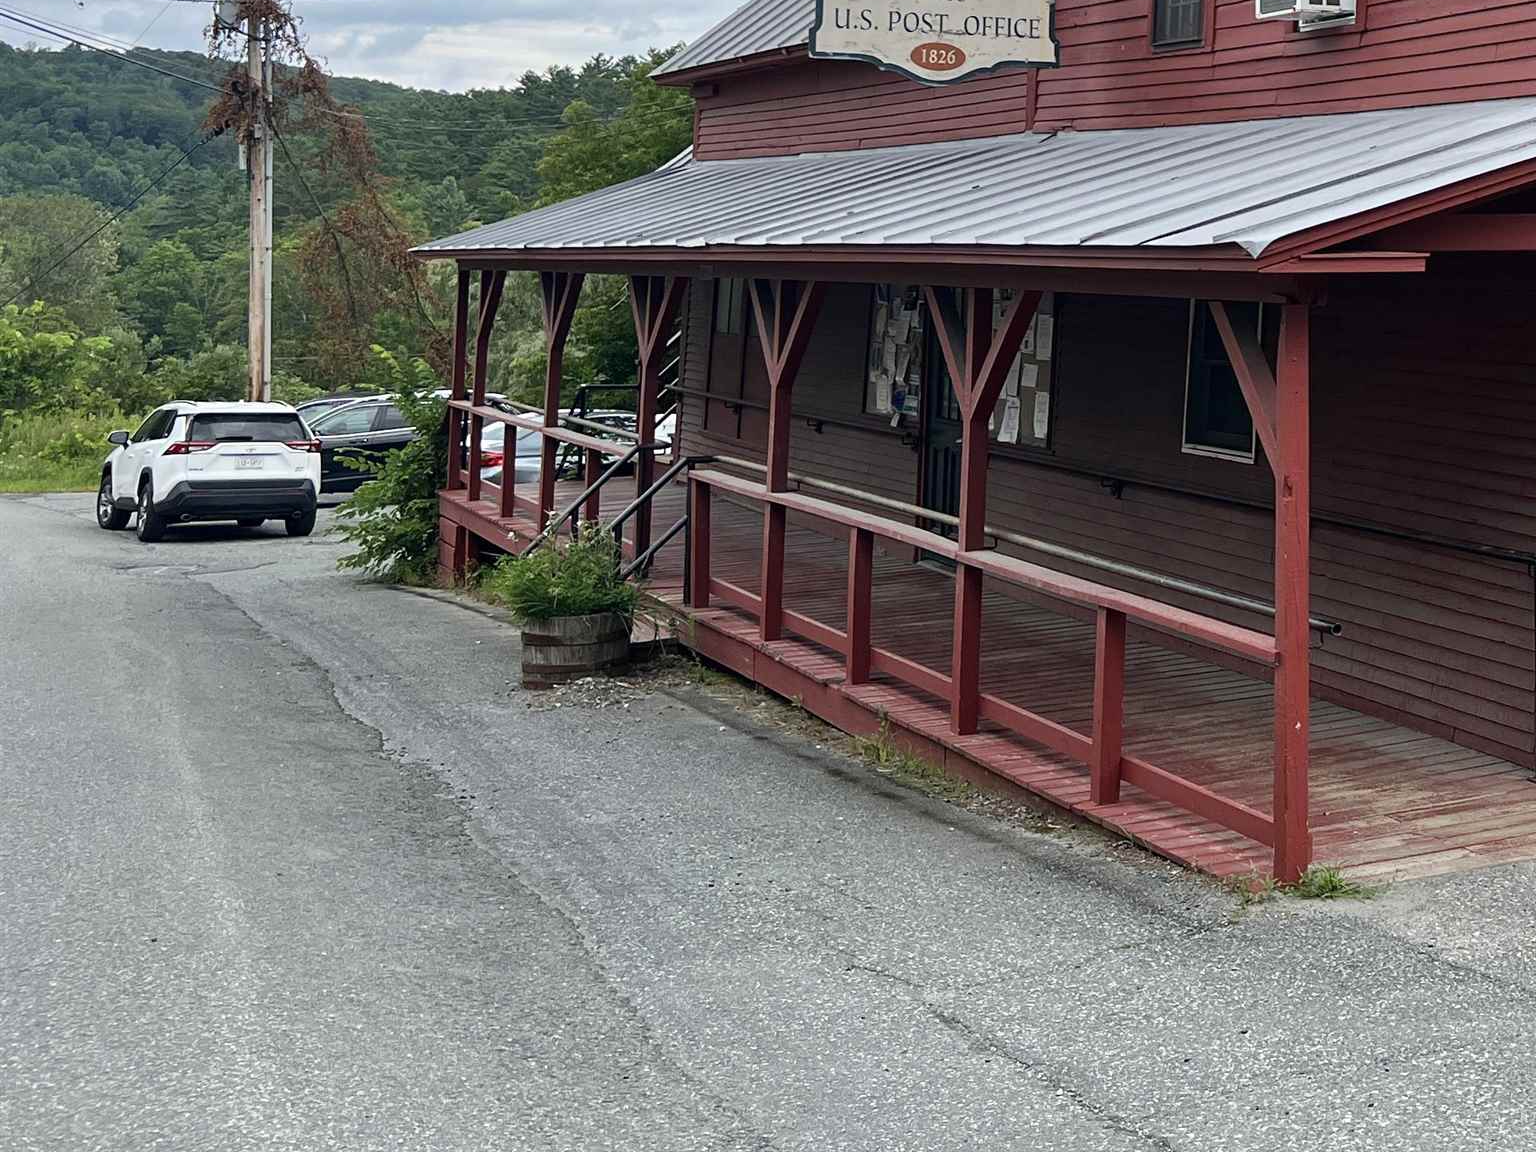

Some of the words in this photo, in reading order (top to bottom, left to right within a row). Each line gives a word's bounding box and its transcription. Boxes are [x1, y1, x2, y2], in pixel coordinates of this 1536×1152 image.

[834, 7, 879, 30] U.S.
[888, 10, 949, 35] POST
[963, 15, 1041, 39] OFFICE
[921, 48, 957, 65] 1826
